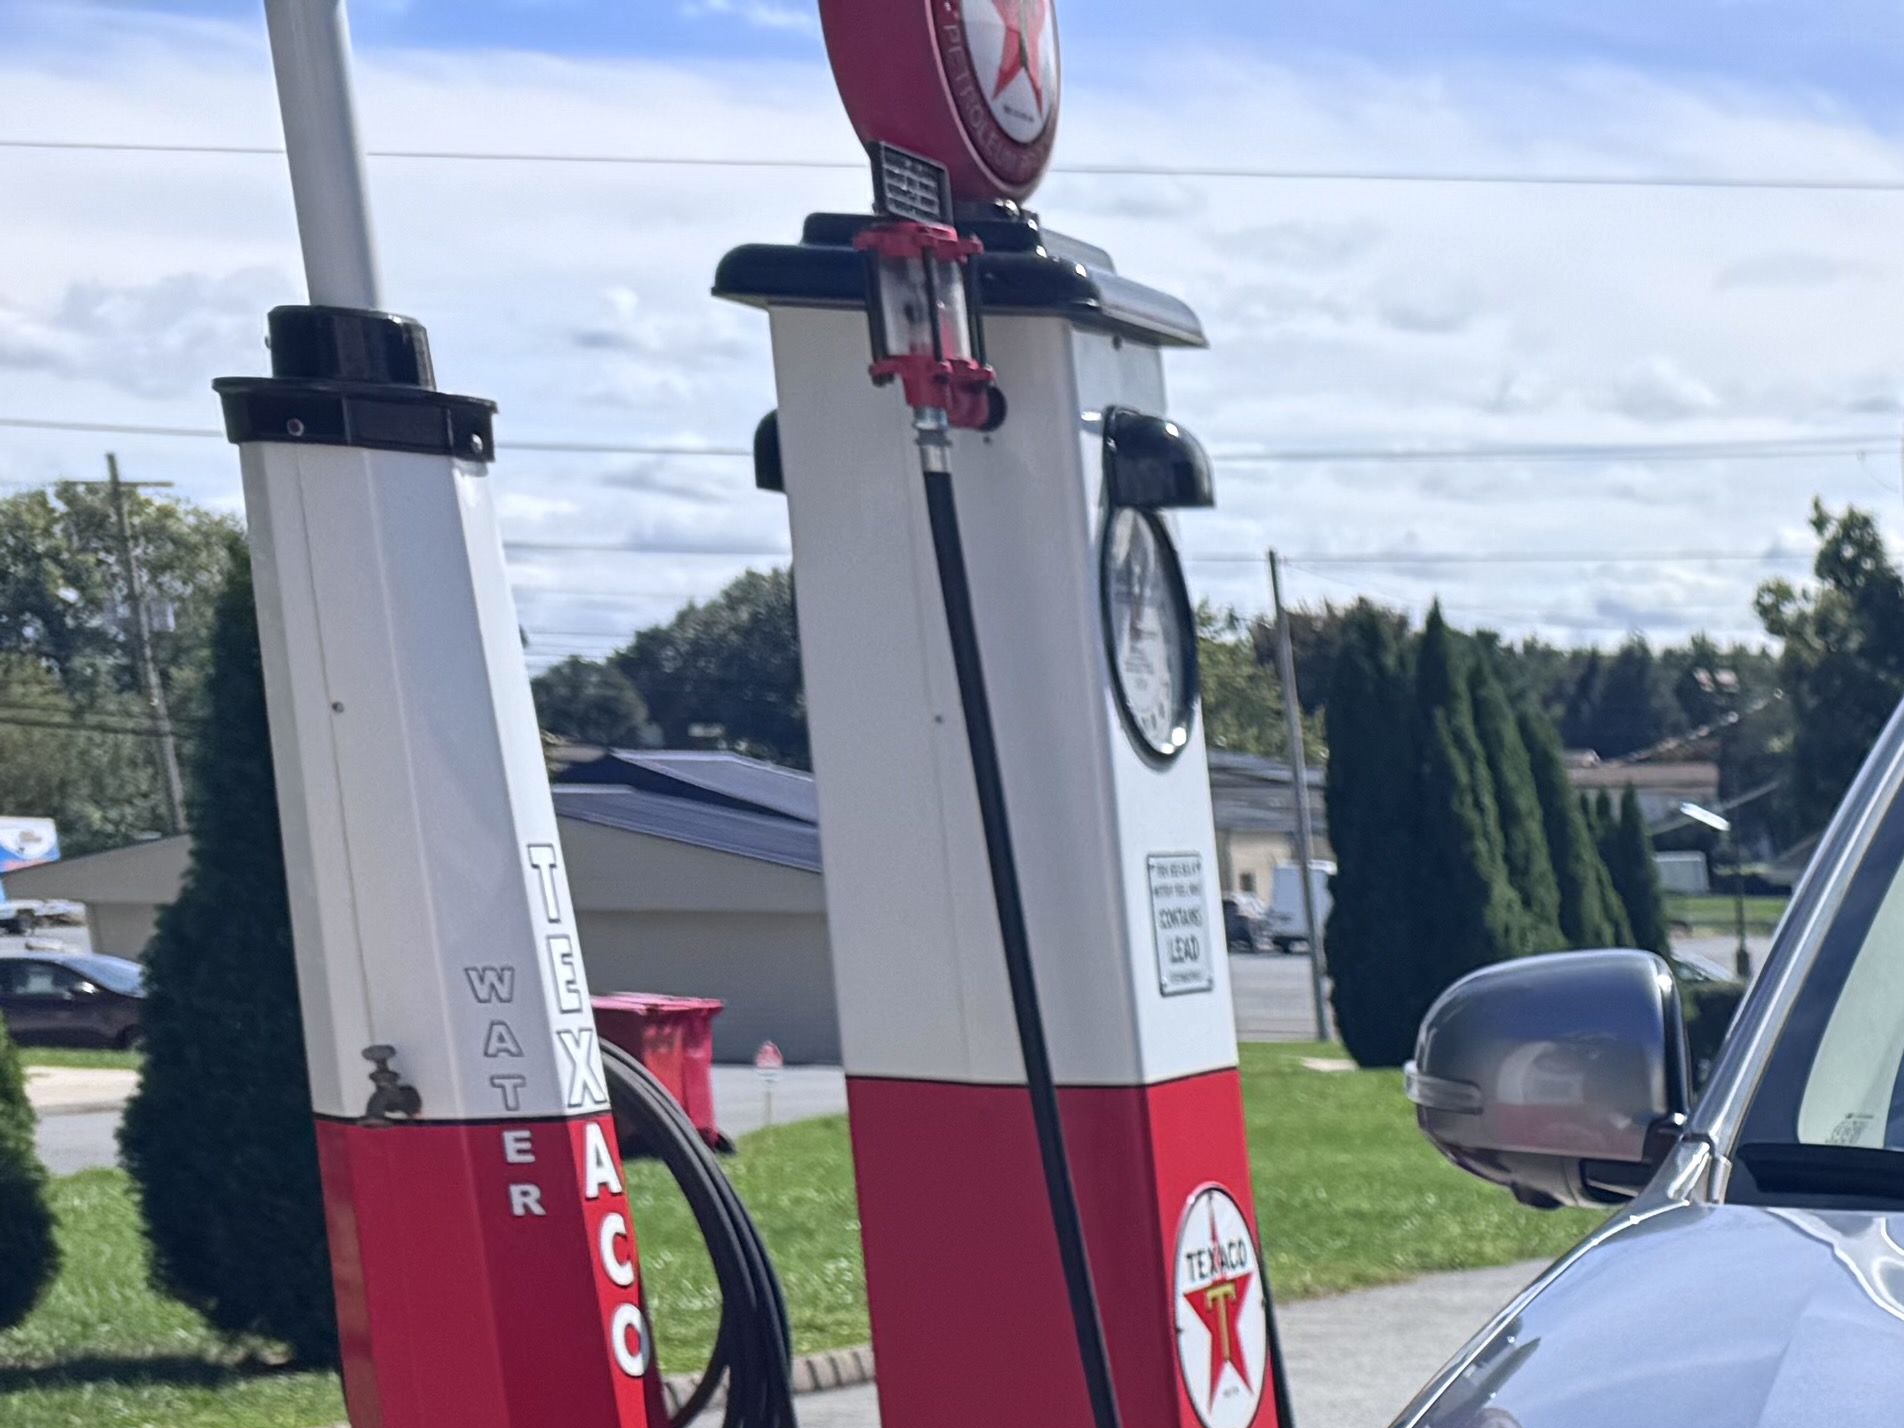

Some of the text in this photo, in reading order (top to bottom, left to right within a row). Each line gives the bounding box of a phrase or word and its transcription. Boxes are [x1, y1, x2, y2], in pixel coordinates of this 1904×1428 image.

[1168, 933, 1200, 963] LEAD
[465, 965, 546, 1216] WATER
[527, 843, 650, 1377] TEXACO
[1186, 1237, 1248, 1282] TEXACO
